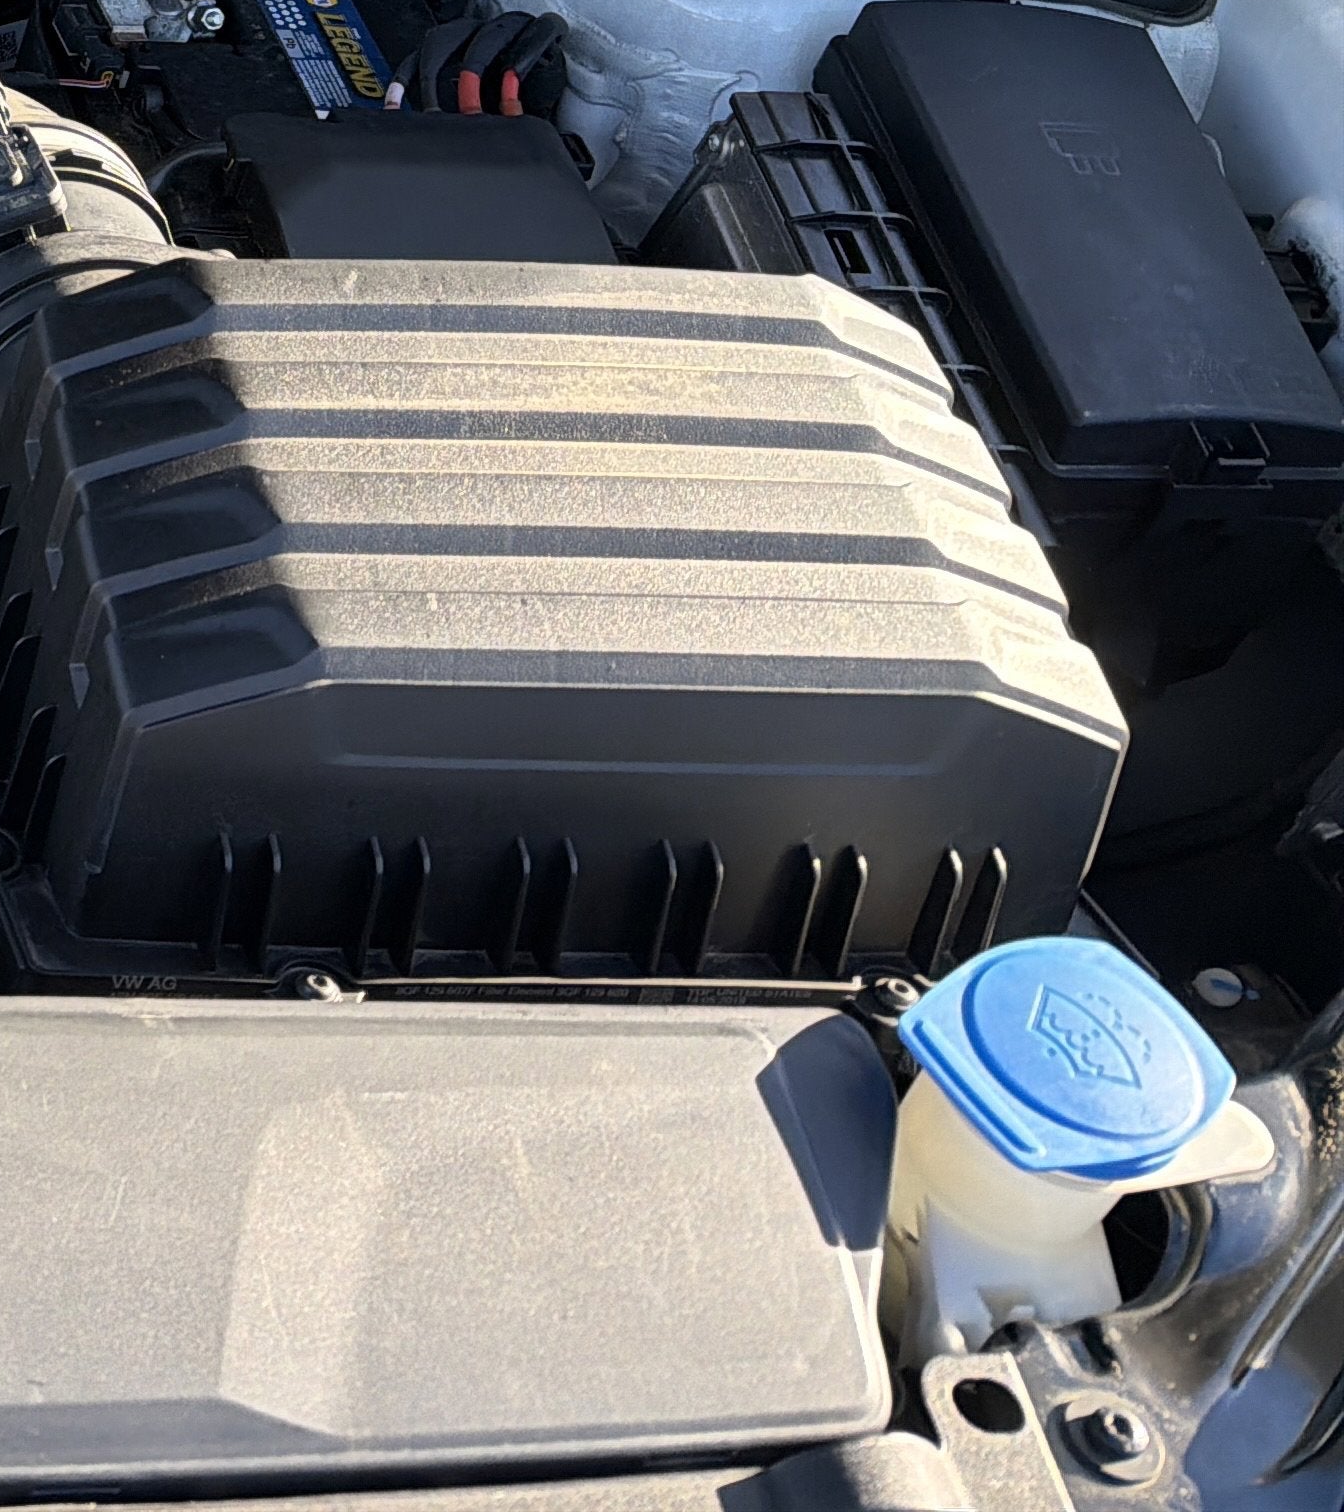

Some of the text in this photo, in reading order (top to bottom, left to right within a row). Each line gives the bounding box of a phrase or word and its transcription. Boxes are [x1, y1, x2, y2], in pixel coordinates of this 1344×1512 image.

[284, 38, 296, 48] Pb
[314, 12, 383, 97] LEGEND
[112, 975, 177, 990] VW AG
